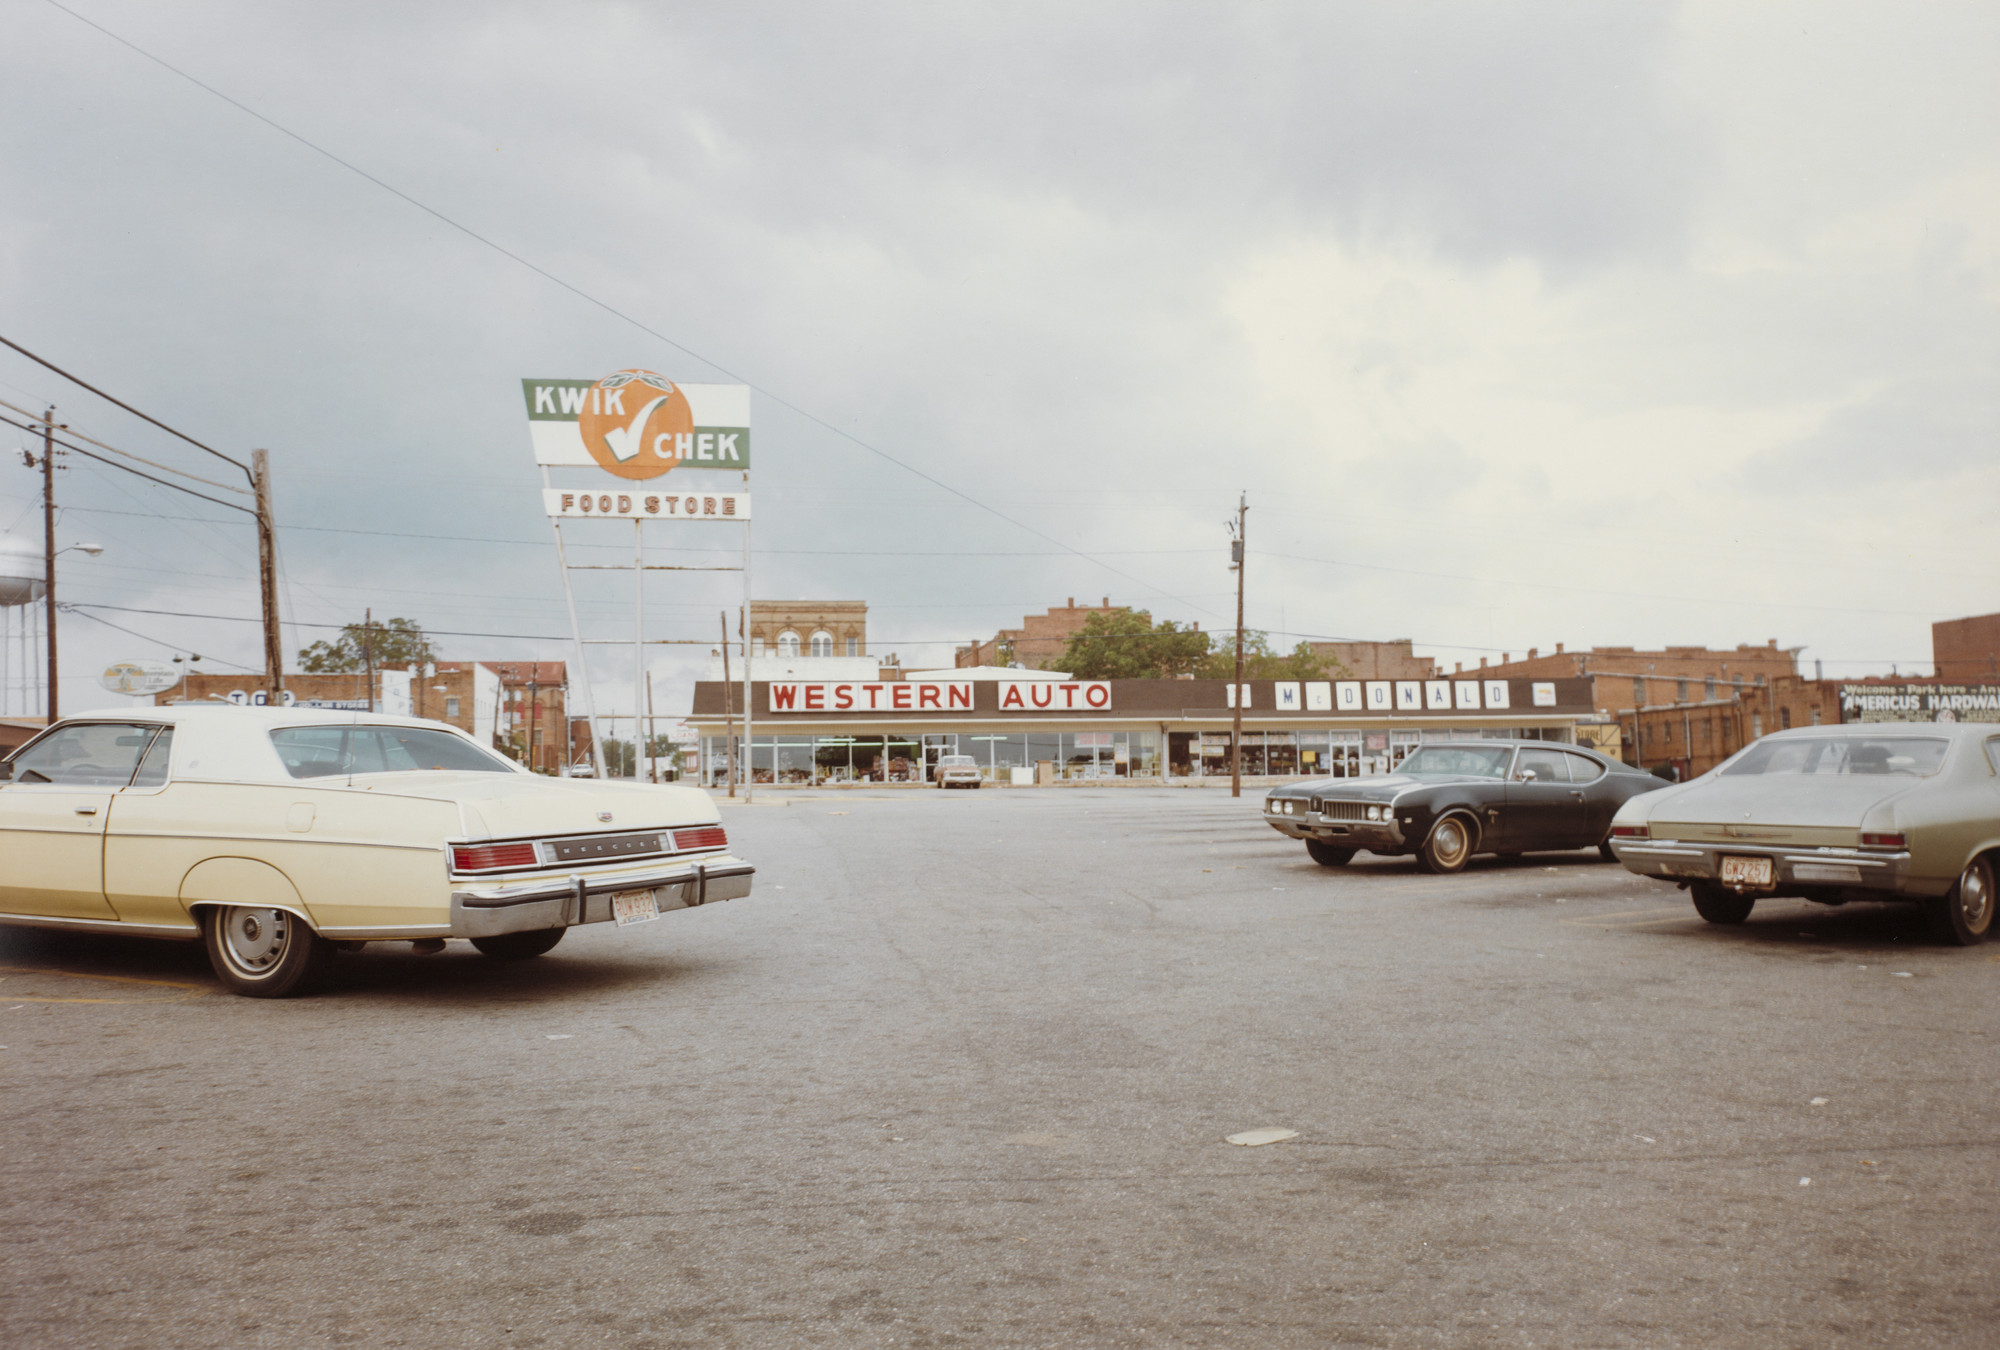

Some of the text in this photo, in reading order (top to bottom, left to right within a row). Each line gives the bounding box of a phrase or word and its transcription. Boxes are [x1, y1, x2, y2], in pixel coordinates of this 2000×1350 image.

[535, 386, 626, 415] KWIK
[653, 432, 740, 461] CHEK
[561, 493, 736, 516] FOOD STORE
[772, 683, 1109, 710] WESTERN AUTO
[1844, 684, 1897, 696] Welcome
[1907, 684, 1936, 695] Park
[1939, 684, 1966, 695] here
[1844, 694, 2000, 711] AMERICUS HARDWA
[563, 840, 657, 853] MERCURY
[1747, 863, 1768, 878] 257
